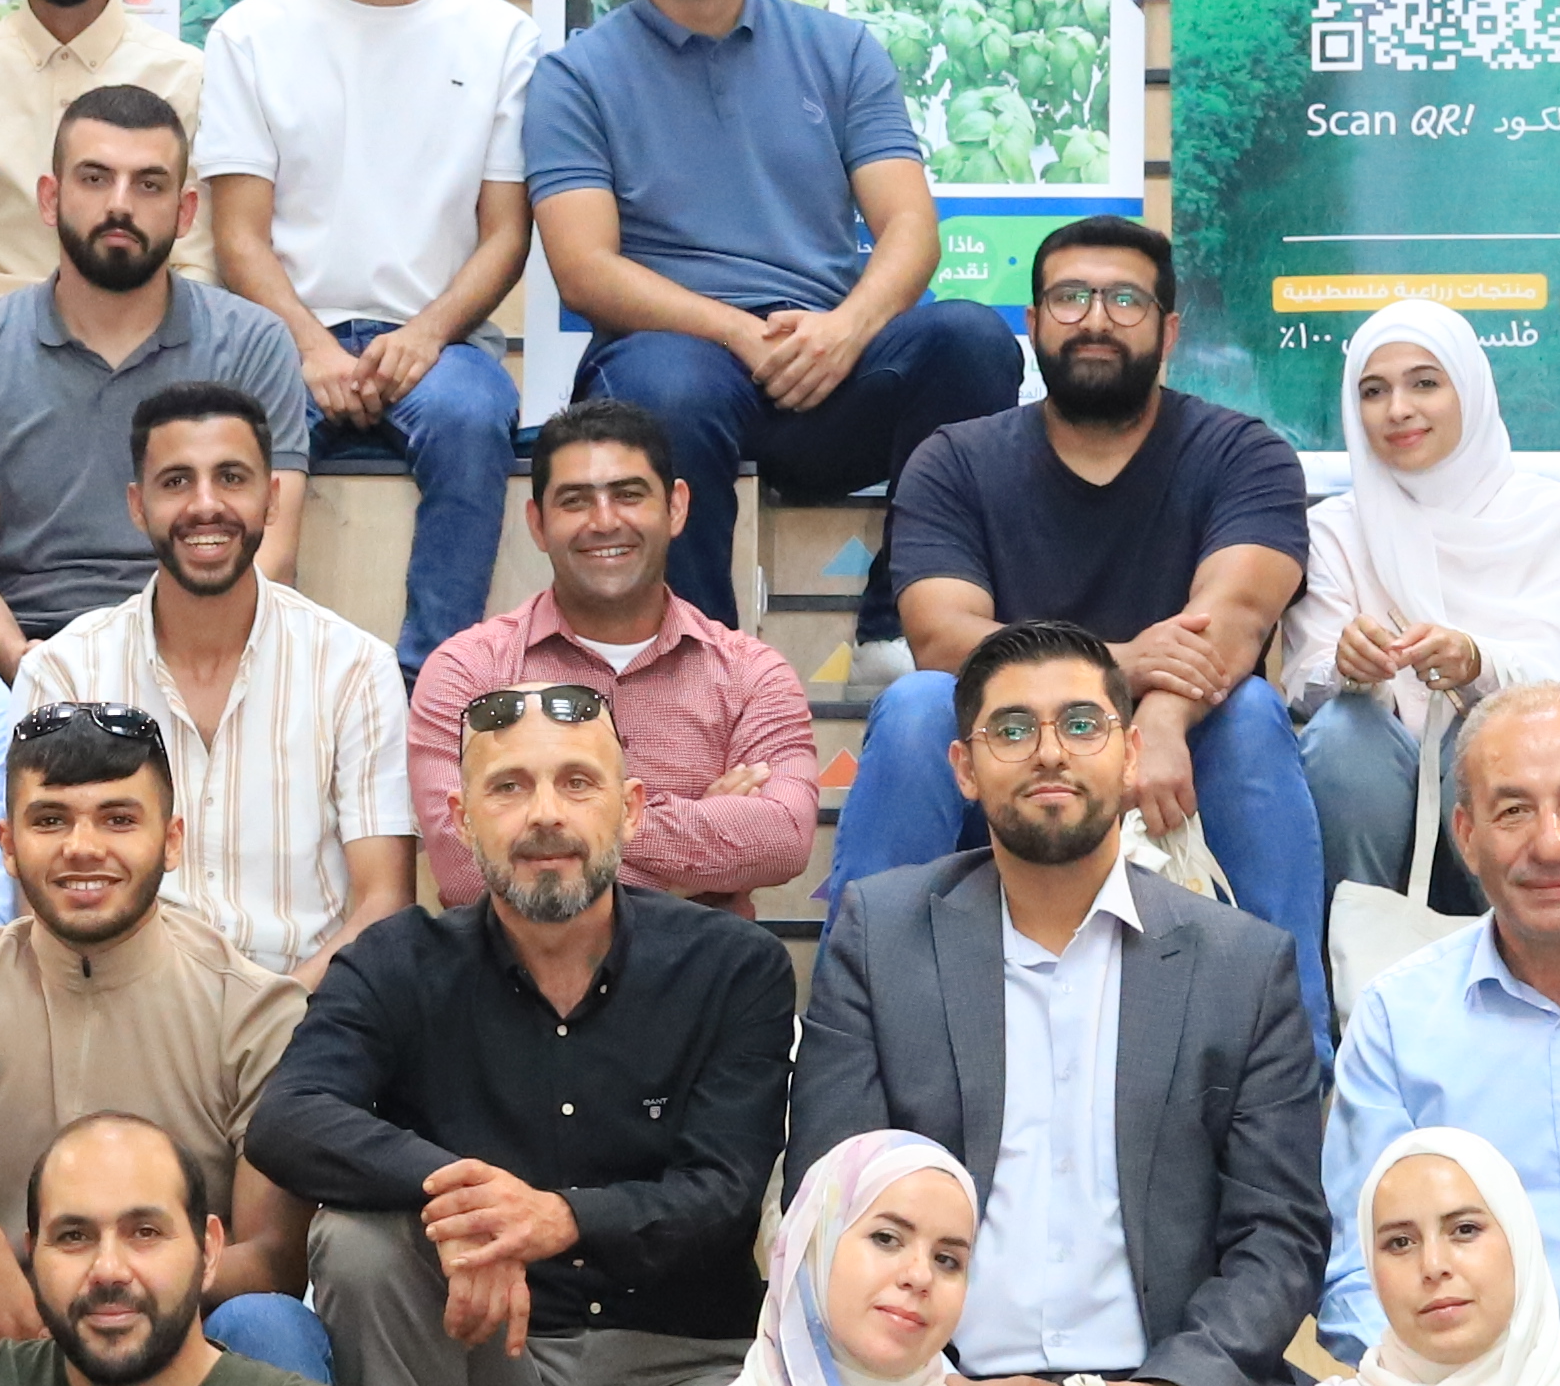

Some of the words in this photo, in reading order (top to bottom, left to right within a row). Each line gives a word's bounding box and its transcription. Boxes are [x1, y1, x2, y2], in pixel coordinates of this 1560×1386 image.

[1306, 103, 1397, 137] Scan
[1409, 103, 1475, 138] QR!
[948, 235, 985, 253] ماذا
[938, 262, 989, 283] نقدم
[1282, 284, 1390, 304] فلسطينية
[1393, 282, 1454, 301] زراعية
[1457, 282, 1537, 300] منتجات
